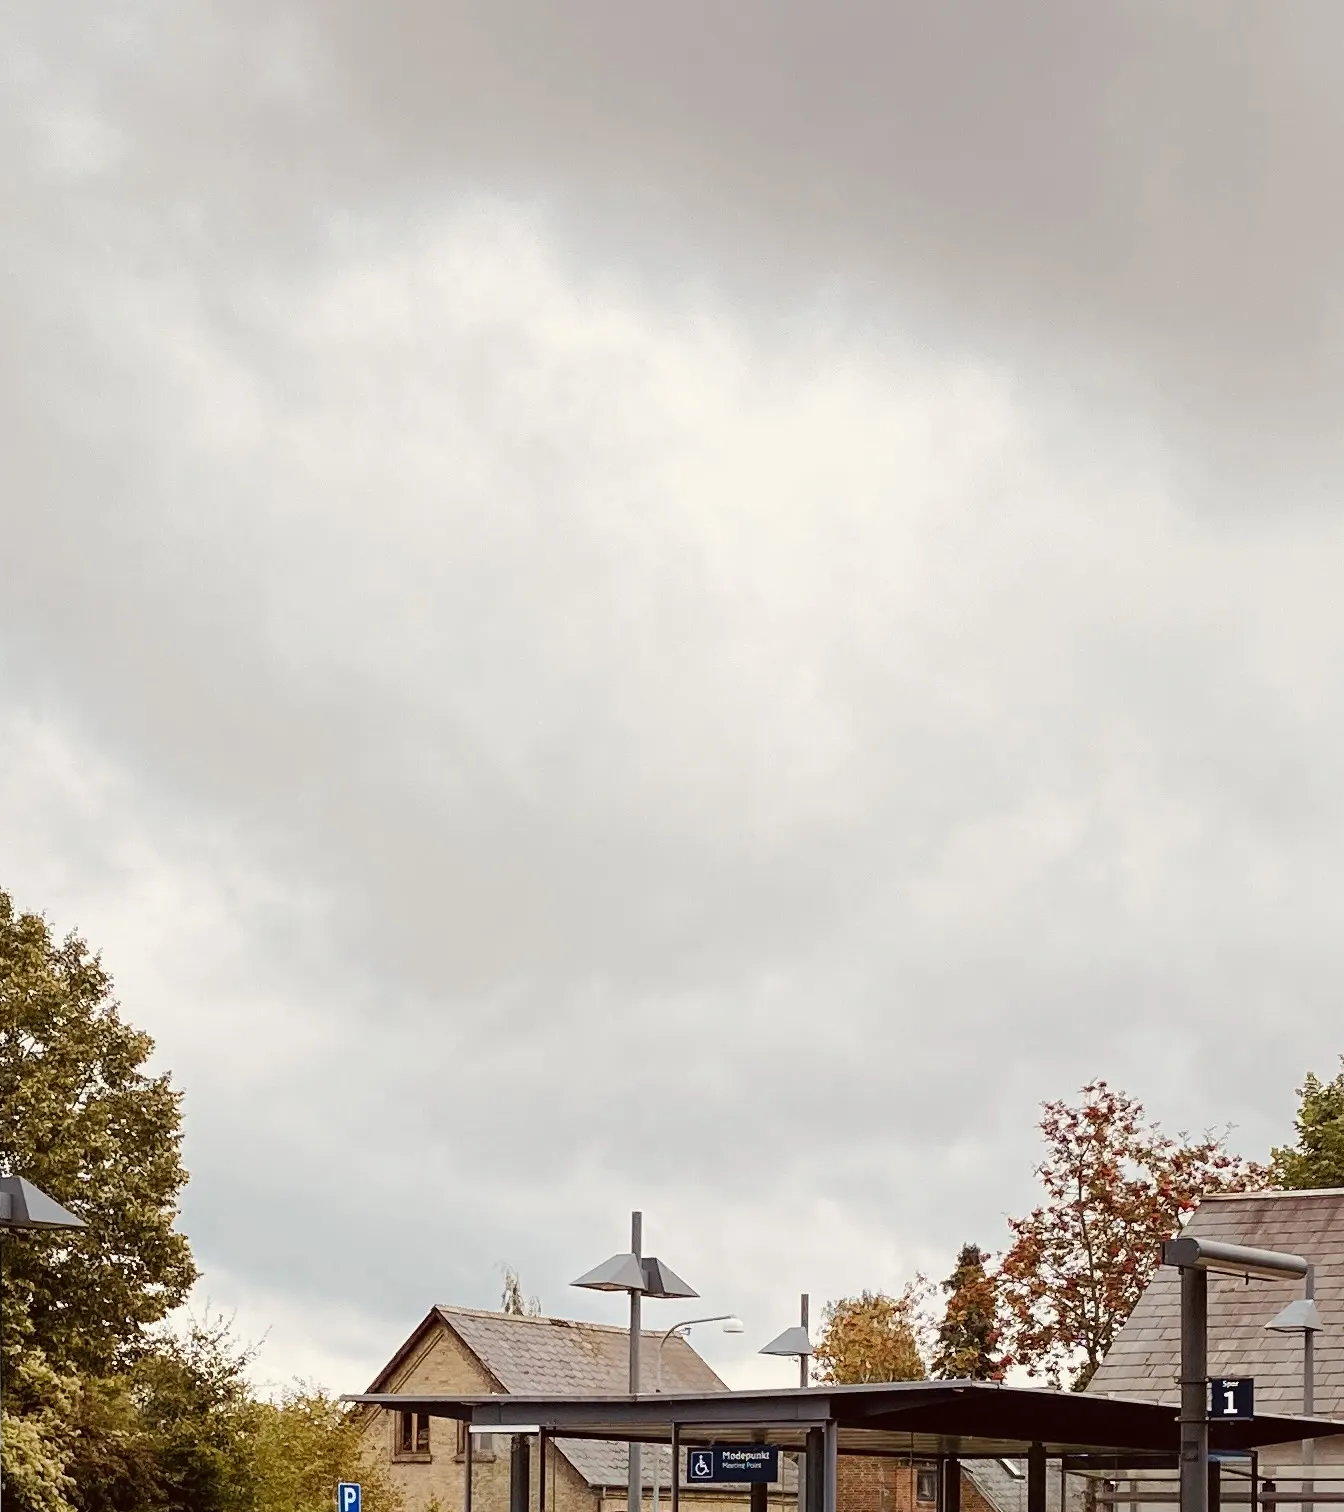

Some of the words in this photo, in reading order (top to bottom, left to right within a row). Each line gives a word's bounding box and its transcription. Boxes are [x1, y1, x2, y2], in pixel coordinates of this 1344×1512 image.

[1222, 1380, 1239, 1388] Spor
[1223, 1391, 1238, 1414] 1
[722, 1451, 770, 1461] Mødepunkt
[344, 1487, 356, 1512] P
